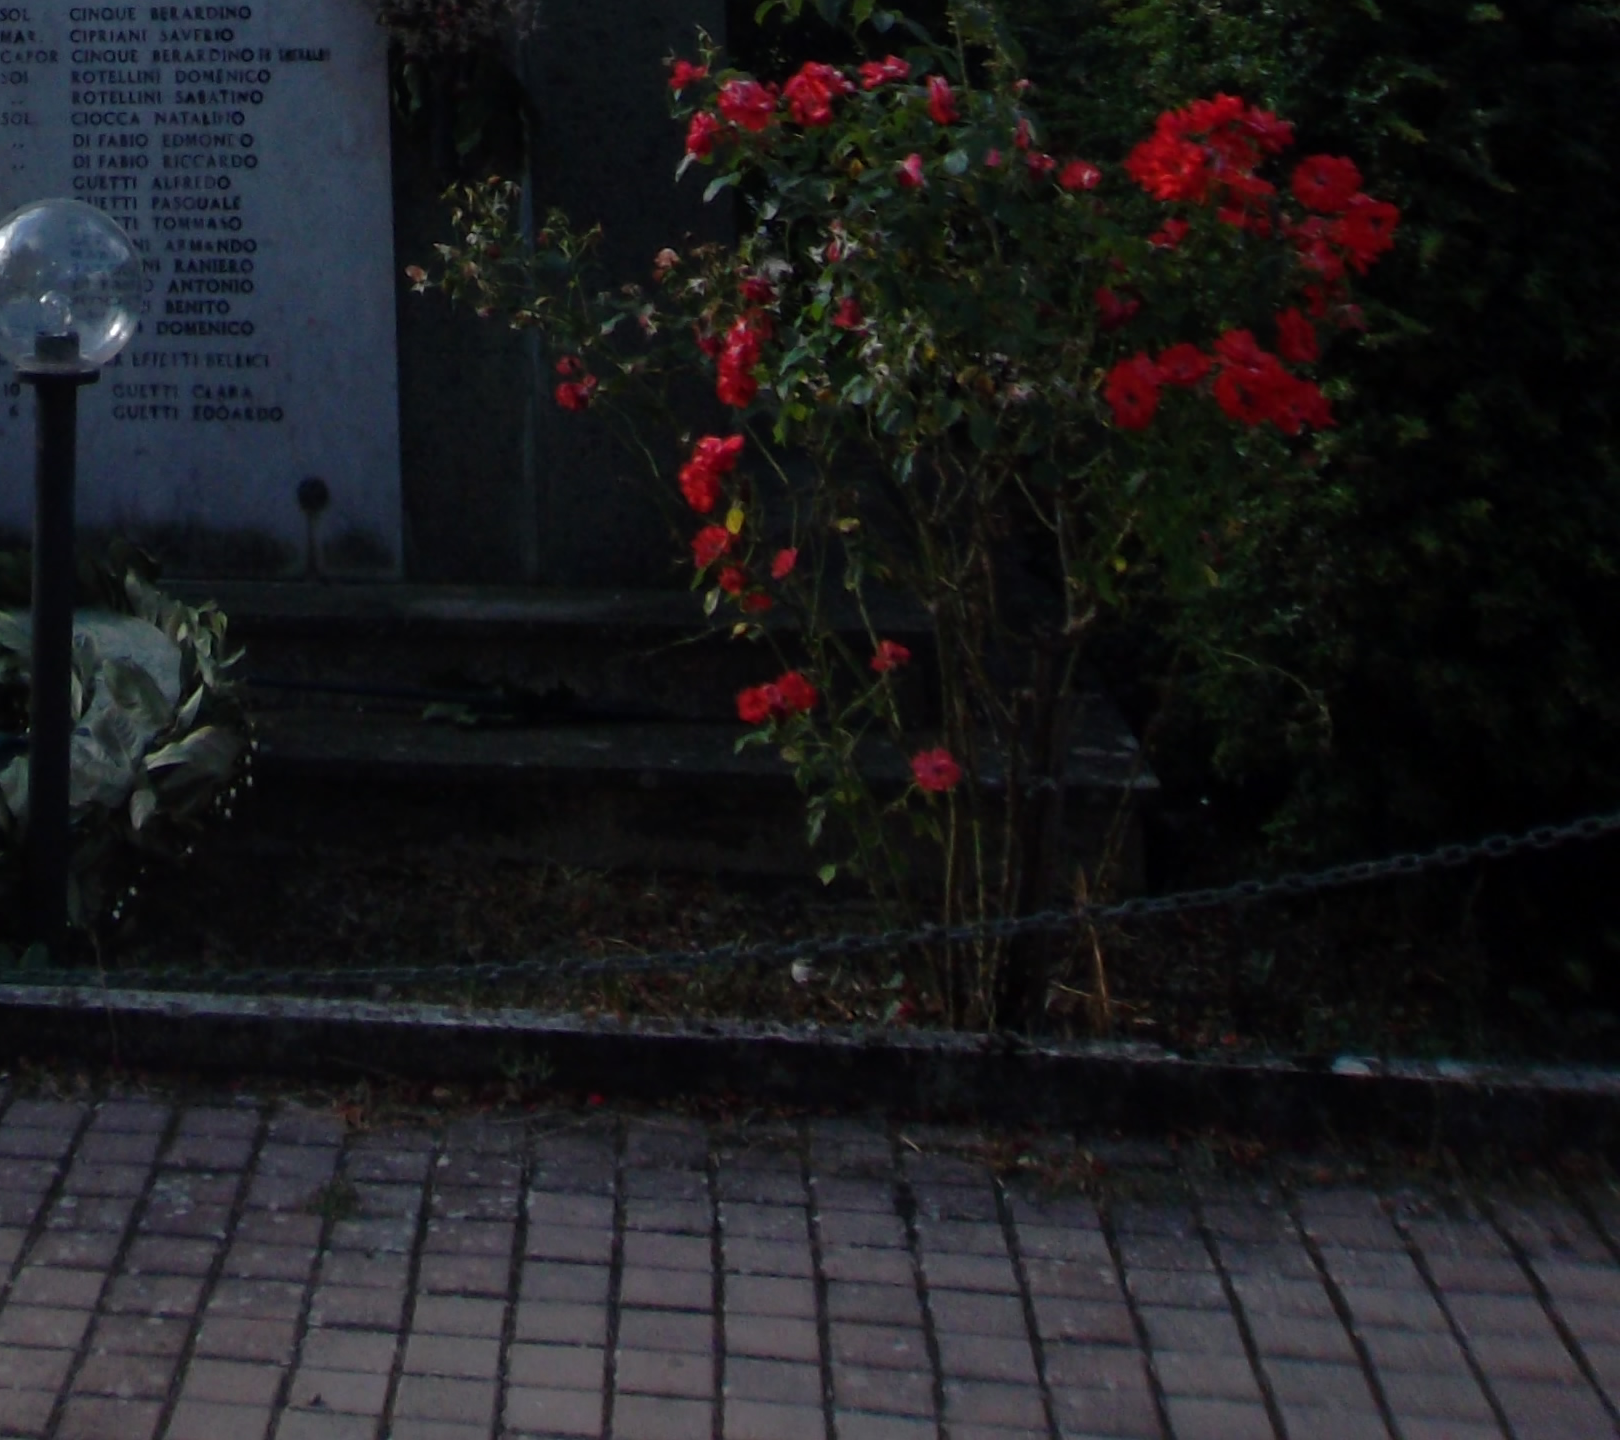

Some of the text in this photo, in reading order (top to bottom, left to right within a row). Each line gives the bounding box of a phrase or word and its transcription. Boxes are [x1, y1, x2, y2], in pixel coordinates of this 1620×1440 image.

[69, 7, 136, 22] CINQUE
[150, 5, 252, 22] BERARDINO
[69, 28, 147, 44] CIPRIANI
[159, 27, 234, 43] SAVERIO
[71, 48, 138, 64] CINQUE
[153, 47, 255, 63] BERARDINO
[71, 69, 161, 84] ROTELLINI
[175, 68, 271, 84] DOMENICO
[71, 89, 264, 105] ROTELLINI SABATINO
[71, 111, 140, 126] CIOCCA
[154, 110, 246, 126] NATALINO
[72, 132, 254, 148] DI FABIO EDMONDO
[72, 153, 258, 169] DI FABIO RICCARDO
[72, 175, 231, 190] GUETTI ALFREDO
[151, 195, 241, 211] PASQUALE
[152, 215, 242, 231] TOMMASO
[165, 238, 257, 253] ARMANDO
[173, 258, 254, 274] RANIERO
[167, 278, 254, 294] ANTONIO
[165, 299, 230, 315] BENITO
[155, 320, 255, 336] DOMENICO
[112, 383, 179, 399] GUETTI
[112, 405, 179, 421] GUETTI
[191, 405, 284, 422] EDOARDO
